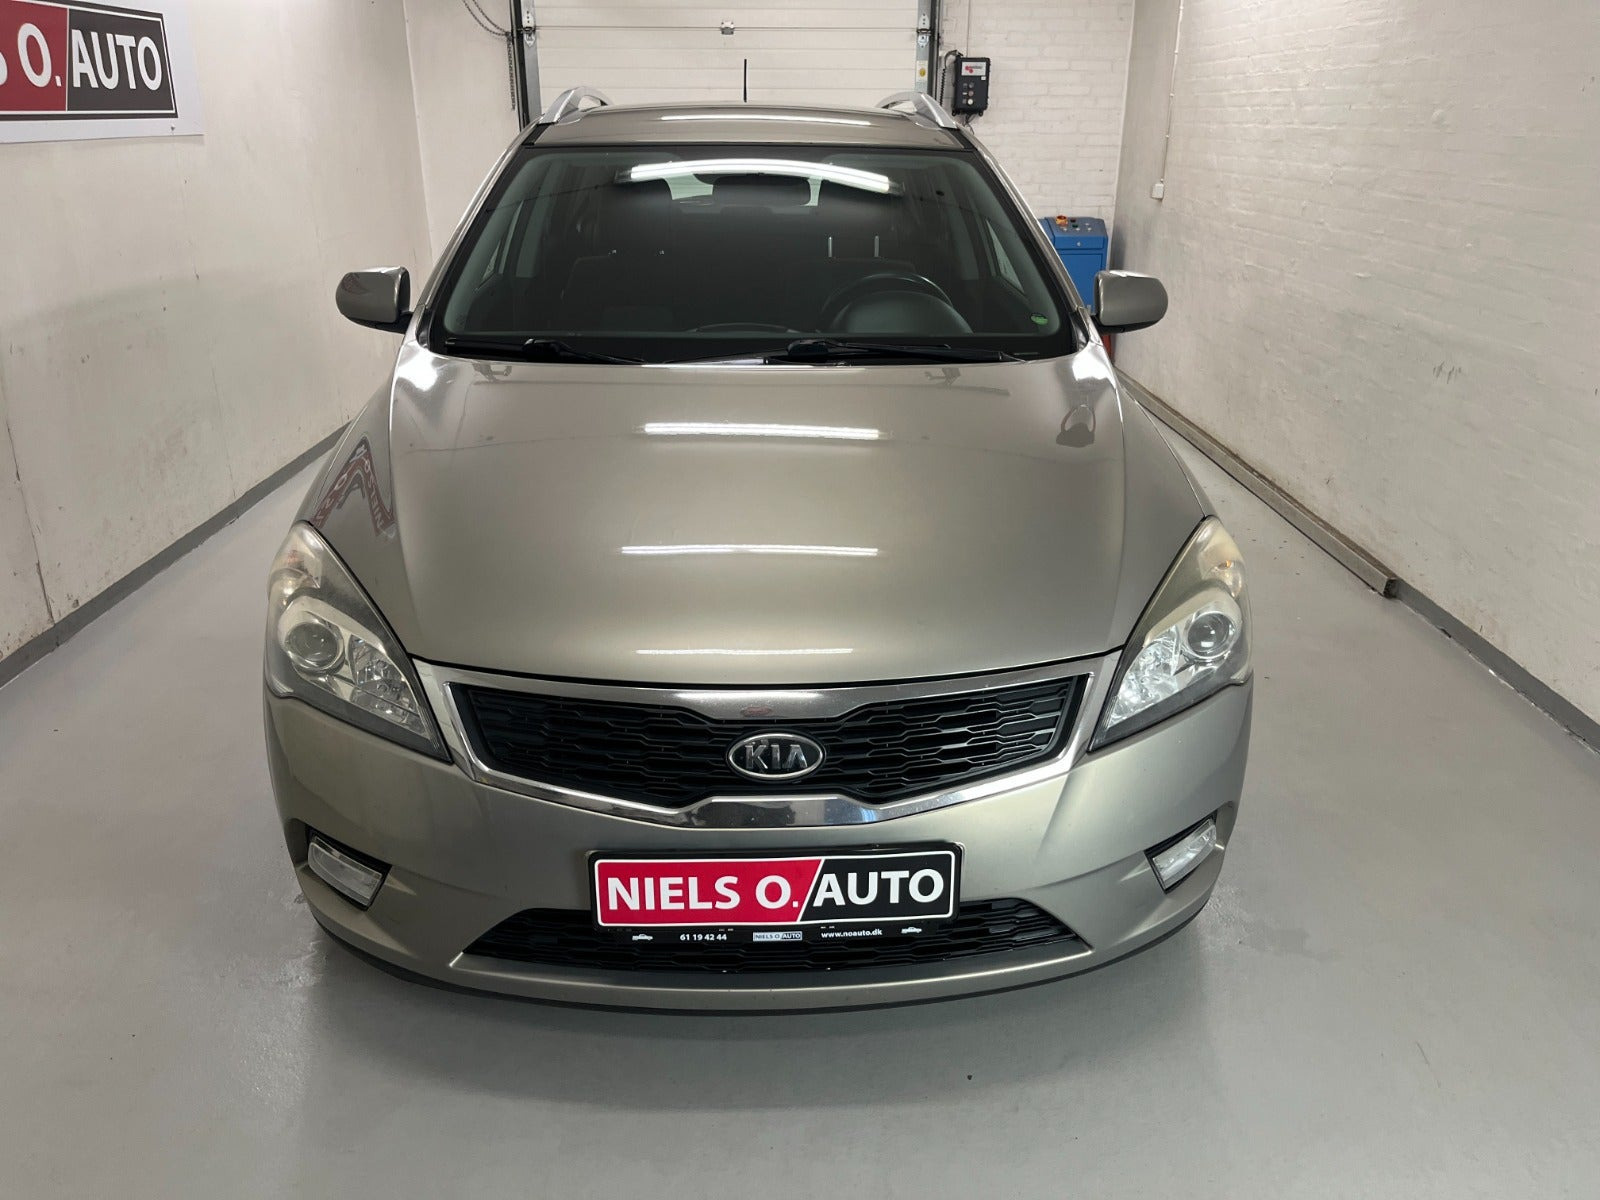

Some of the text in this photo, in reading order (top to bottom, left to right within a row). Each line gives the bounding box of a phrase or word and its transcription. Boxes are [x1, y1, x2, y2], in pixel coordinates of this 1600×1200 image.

[17, 22, 62, 88] O.
[71, 29, 163, 91] AUTO
[744, 743, 808, 770] KIA
[607, 868, 945, 911] NIELS O. AUTO
[679, 933, 728, 941] 61 19 42 44
[821, 928, 883, 938] www.noauto.dk
